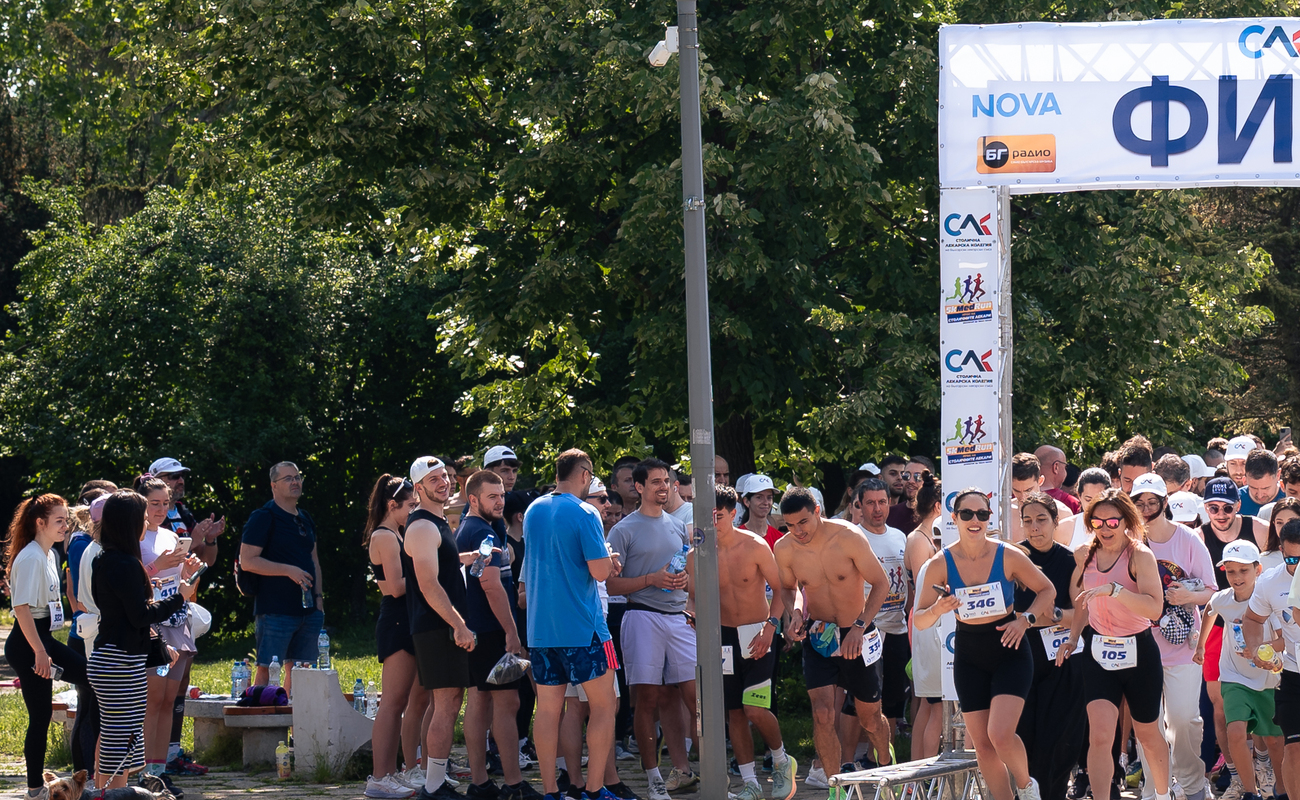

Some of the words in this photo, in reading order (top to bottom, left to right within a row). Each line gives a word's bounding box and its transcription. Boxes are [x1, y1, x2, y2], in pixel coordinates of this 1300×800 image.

[972, 92, 1062, 118] NOVA
[986, 149, 1007, 161] БГ
[1012, 149, 1051, 159] радио
[967, 598, 995, 610] 346
[1102, 650, 1127, 660] 105
